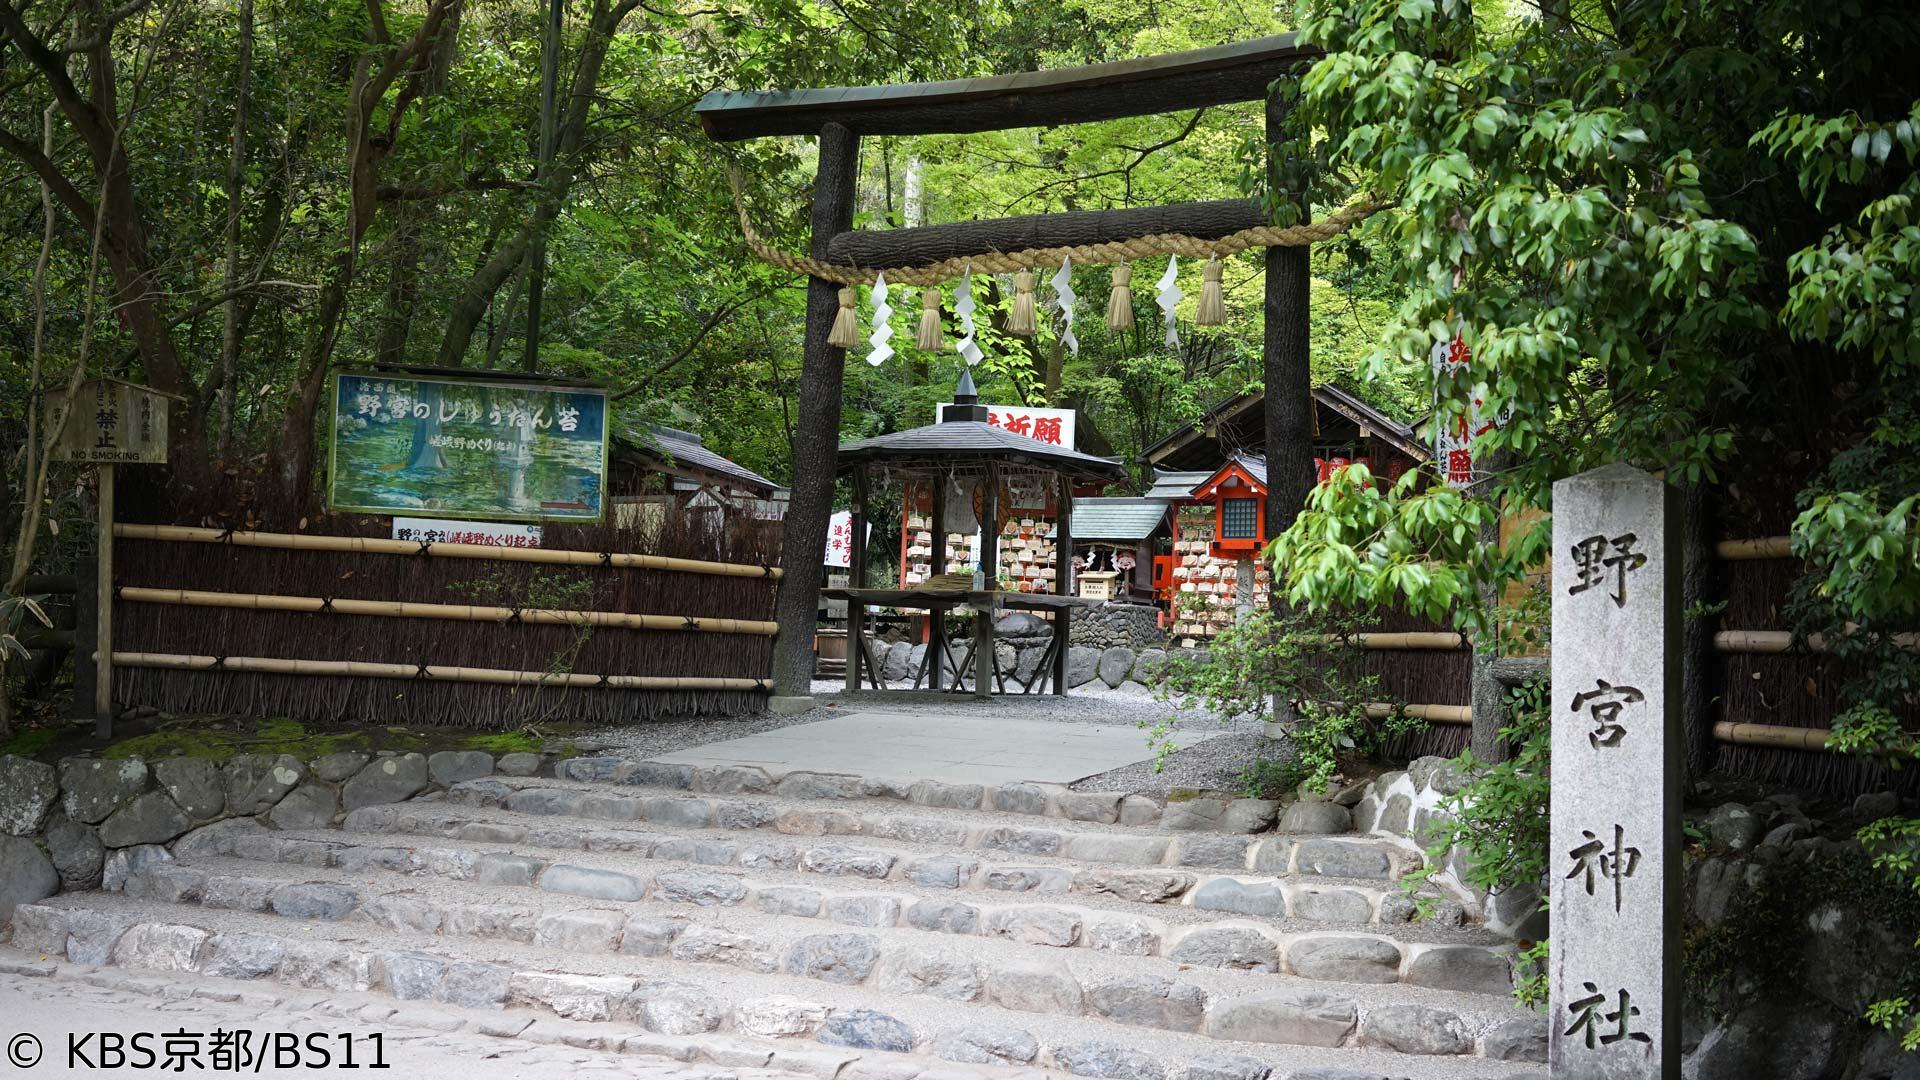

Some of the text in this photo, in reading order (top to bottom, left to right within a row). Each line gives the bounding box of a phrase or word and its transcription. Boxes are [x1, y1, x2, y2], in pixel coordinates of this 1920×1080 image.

[71, 450, 140, 461] NO SMOKING
[1564, 531, 1651, 1050] 野宮神社
